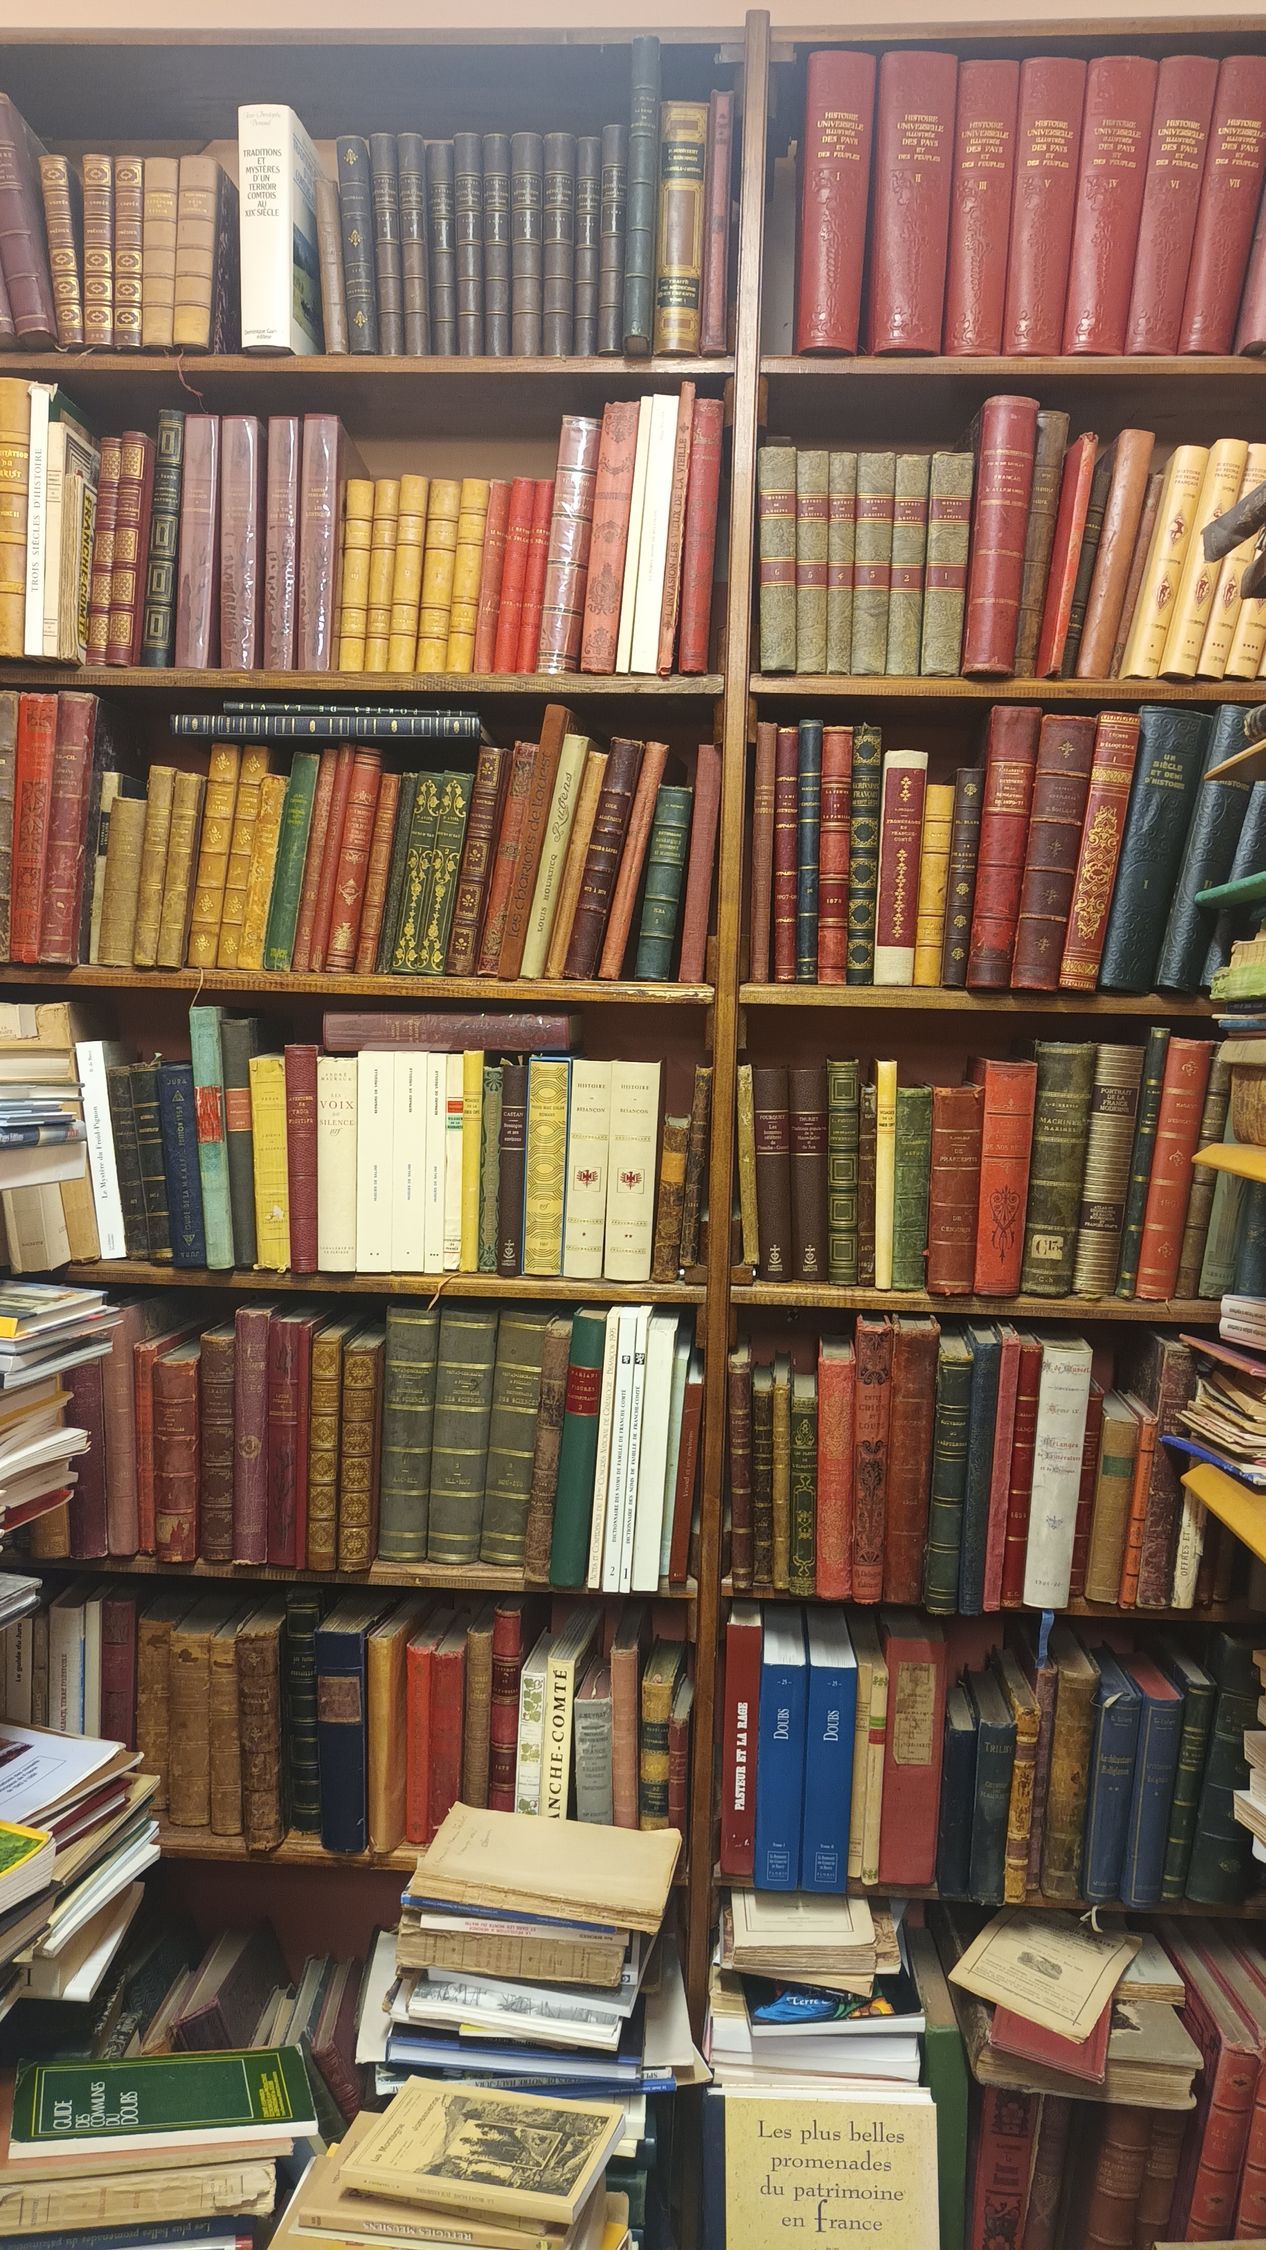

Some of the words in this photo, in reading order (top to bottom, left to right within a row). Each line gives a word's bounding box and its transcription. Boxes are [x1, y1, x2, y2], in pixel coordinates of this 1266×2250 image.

[825, 112, 858, 120] HISTOIRE
[905, 114, 938, 122] HISTOIRE
[818, 121, 864, 131] UNIVERSELLE
[898, 123, 944, 132] UNIVERSELLE
[1035, 120, 1068, 128] HISTOIRE
[1027, 129, 1074, 138] UNIVERSELLE
[834, 152, 860, 160] PEUPLES
[246, 165, 280, 173] MYSTÈRES
[1043, 160, 1069, 168] PEUPLES
[836, 172, 840, 180] I
[1044, 180, 1051, 188] V
[257, 208, 279, 216] SIÈCLE
[678, 438, 687, 473] VIEILLE
[34, 448, 42, 510] D'HISTOIRE
[676, 476, 685, 492] LA
[674, 493, 683, 506] DE
[32, 514, 40, 556] SIÈCLES
[31, 562, 40, 592] TROIS
[238, 702, 267, 711] VIE
[283, 704, 302, 712] LA
[318, 705, 337, 713] DE
[1152, 760, 1183, 772] SIÈCLE
[1164, 771, 1182, 780] DEMI
[1144, 777, 1185, 790] D'HISTOIRE
[537, 907, 547, 932] LOUIS
[543, 854, 558, 900] HOURTICQ
[551, 772, 572, 842] Rubens
[508, 912, 522, 938] Les
[526, 810, 541, 832] de
[1143, 880, 1149, 889] I
[1100, 1088, 1132, 1096] PORTRAIT
[320, 1101, 354, 1109] VOIX
[1100, 1105, 1129, 1113] MODERNE
[95, 1152, 104, 1161] du
[97, 1162, 107, 1188] Mystère
[101, 1189, 108, 1200] Le
[612, 1504, 620, 1543] DICTIONNAIRE
[617, 1408, 626, 1434] FRANCHE
[1183, 1531, 1190, 1541] ET
[1181, 1545, 1190, 1576] OFFRES
[610, 1566, 616, 1576] 2
[624, 1568, 628, 1579] 1
[16, 1640, 22, 1650] du
[737, 1702, 748, 1728] RAGE
[774, 1708, 790, 1739] DOUBS
[824, 1710, 839, 1741] DOUBS
[548, 1668, 567, 1819] ANCHE-COMTÉ
[737, 1732, 747, 1746] LA
[736, 1749, 747, 1762] ET
[735, 1766, 746, 1810] PASTEUR
[90, 2081, 105, 2128] COMMUNES
[120, 2091, 138, 2125] DOUBS
[52, 2100, 72, 2130] GUIDE
[76, 2114, 90, 2129] DES
[106, 2113, 121, 2126] DU
[758, 2120, 792, 2138] Les
[800, 2120, 841, 2144] plus
[849, 2121, 905, 2144] belles
[370, 2154, 382, 2162] La
[378, 2124, 404, 2152] Montagne
[771, 2150, 892, 2172] promenades
[760, 2175, 784, 2196] du
[793, 2183, 904, 2201] patrimoine
[781, 2217, 805, 2227] en
[814, 2199, 883, 2233] france
[172, 2222, 192, 2235] plus
[194, 2222, 210, 2232] Les
[362, 2222, 415, 2237] MEUSIENS
[82, 2228, 139, 2244] promenades
[142, 2228, 169, 2240] belles
[66, 2238, 79, 2248] du
